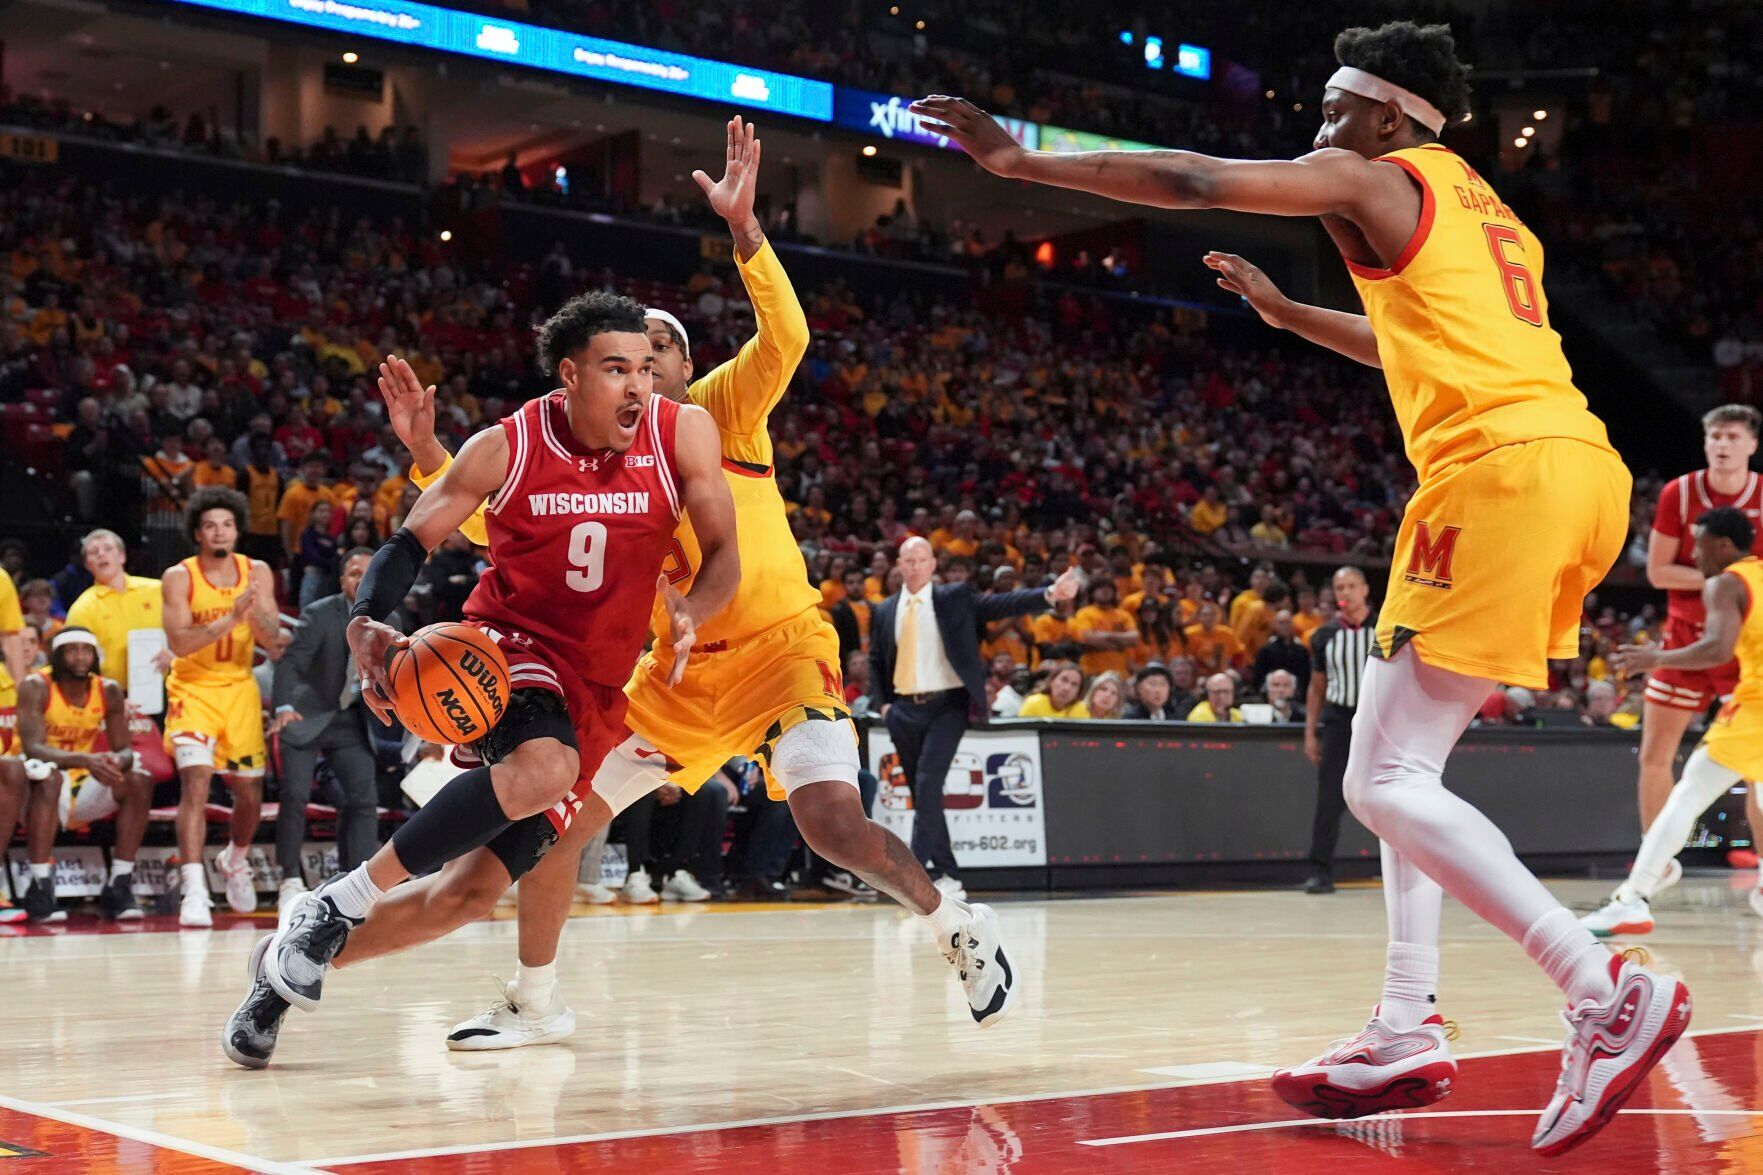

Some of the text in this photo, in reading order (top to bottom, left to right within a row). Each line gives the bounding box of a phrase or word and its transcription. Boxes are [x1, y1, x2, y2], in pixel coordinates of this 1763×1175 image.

[869, 96, 949, 148] xfin
[1482, 222, 1543, 328] 6
[528, 491, 650, 516] WISCONSIN
[565, 521, 607, 593] 9
[1405, 520, 1462, 581] M
[436, 688, 478, 736] NCAA
[459, 650, 503, 719] Wilson
[951, 835, 1037, 854] ers-602.org
